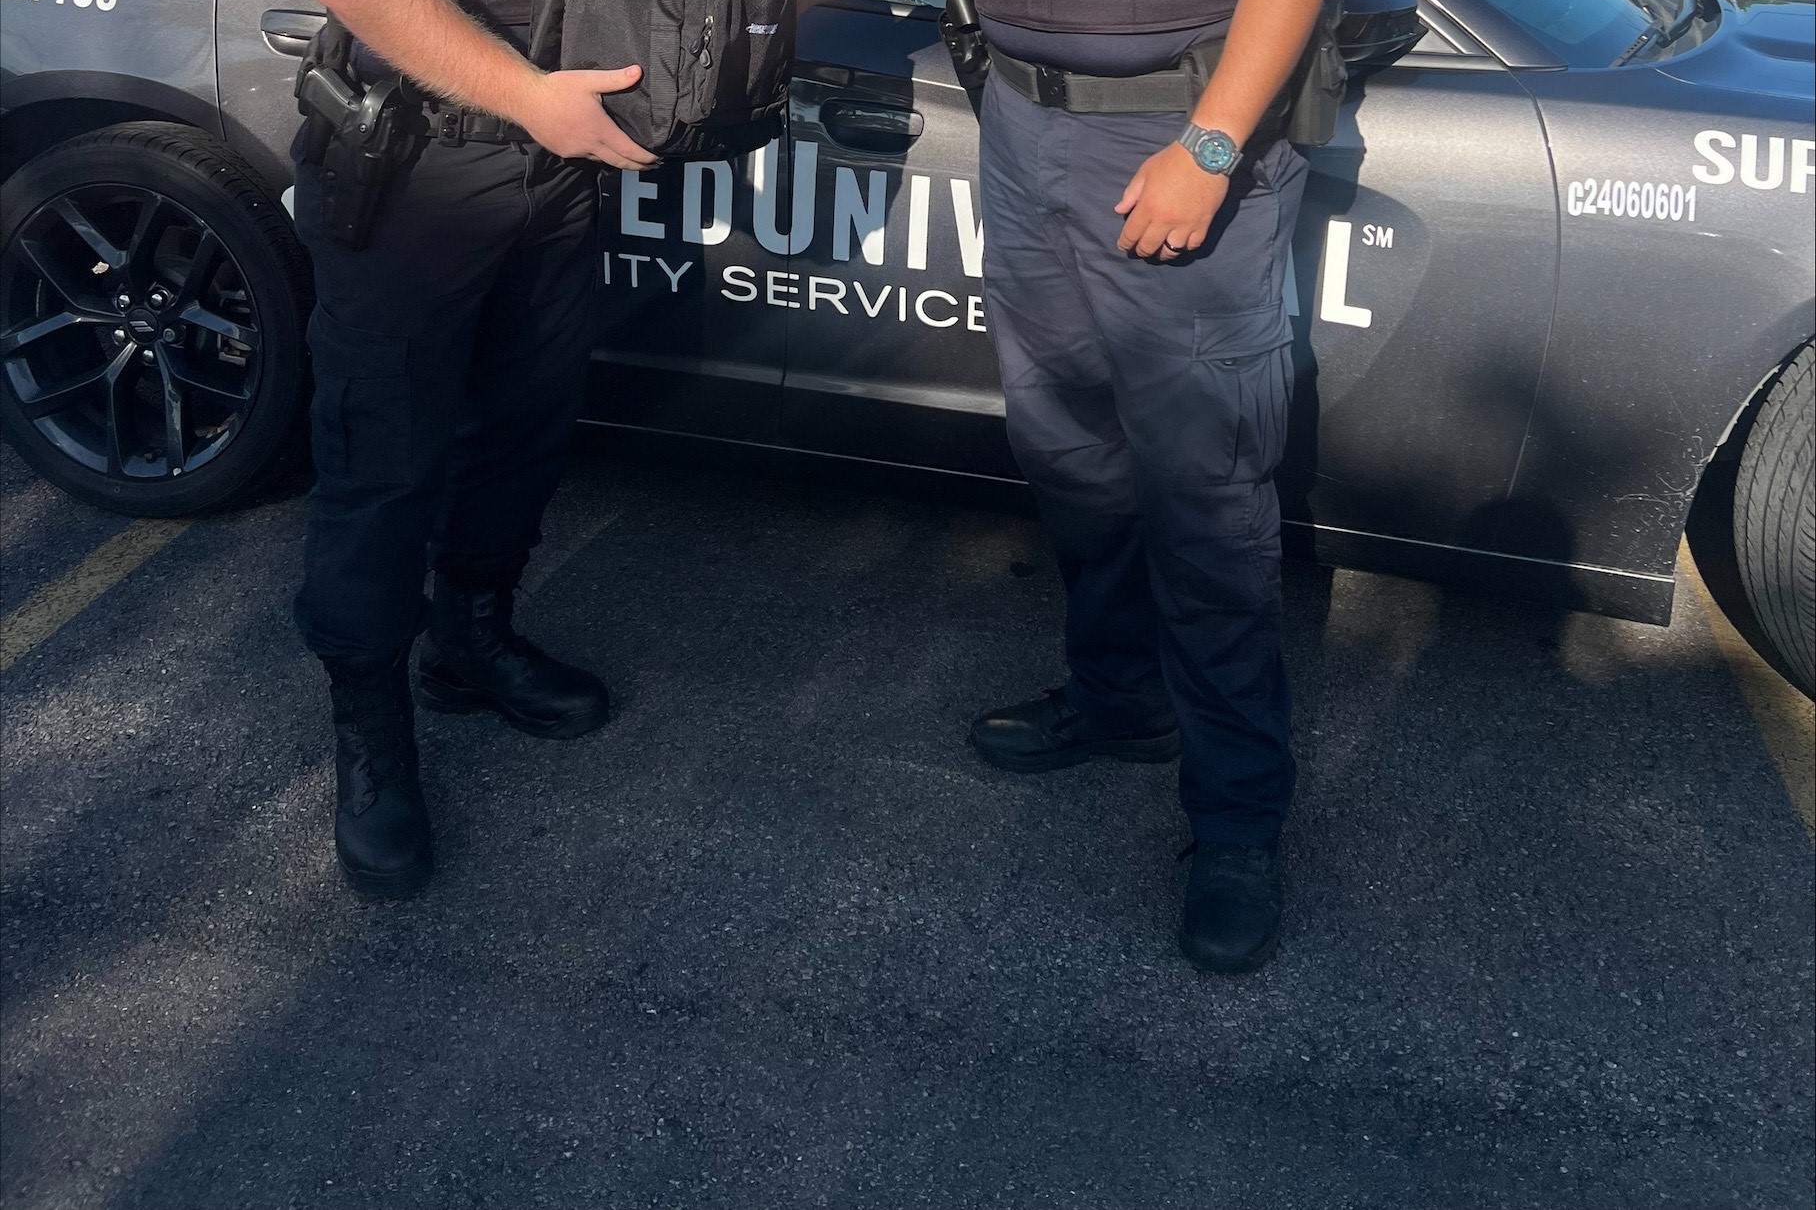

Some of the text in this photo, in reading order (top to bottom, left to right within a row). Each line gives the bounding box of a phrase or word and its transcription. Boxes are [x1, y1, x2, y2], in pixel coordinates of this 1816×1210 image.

[621, 138, 1394, 328] EDUNIV L SM
[1567, 178, 1696, 221] C24060601
[604, 251, 987, 332] ITY SERVICE
